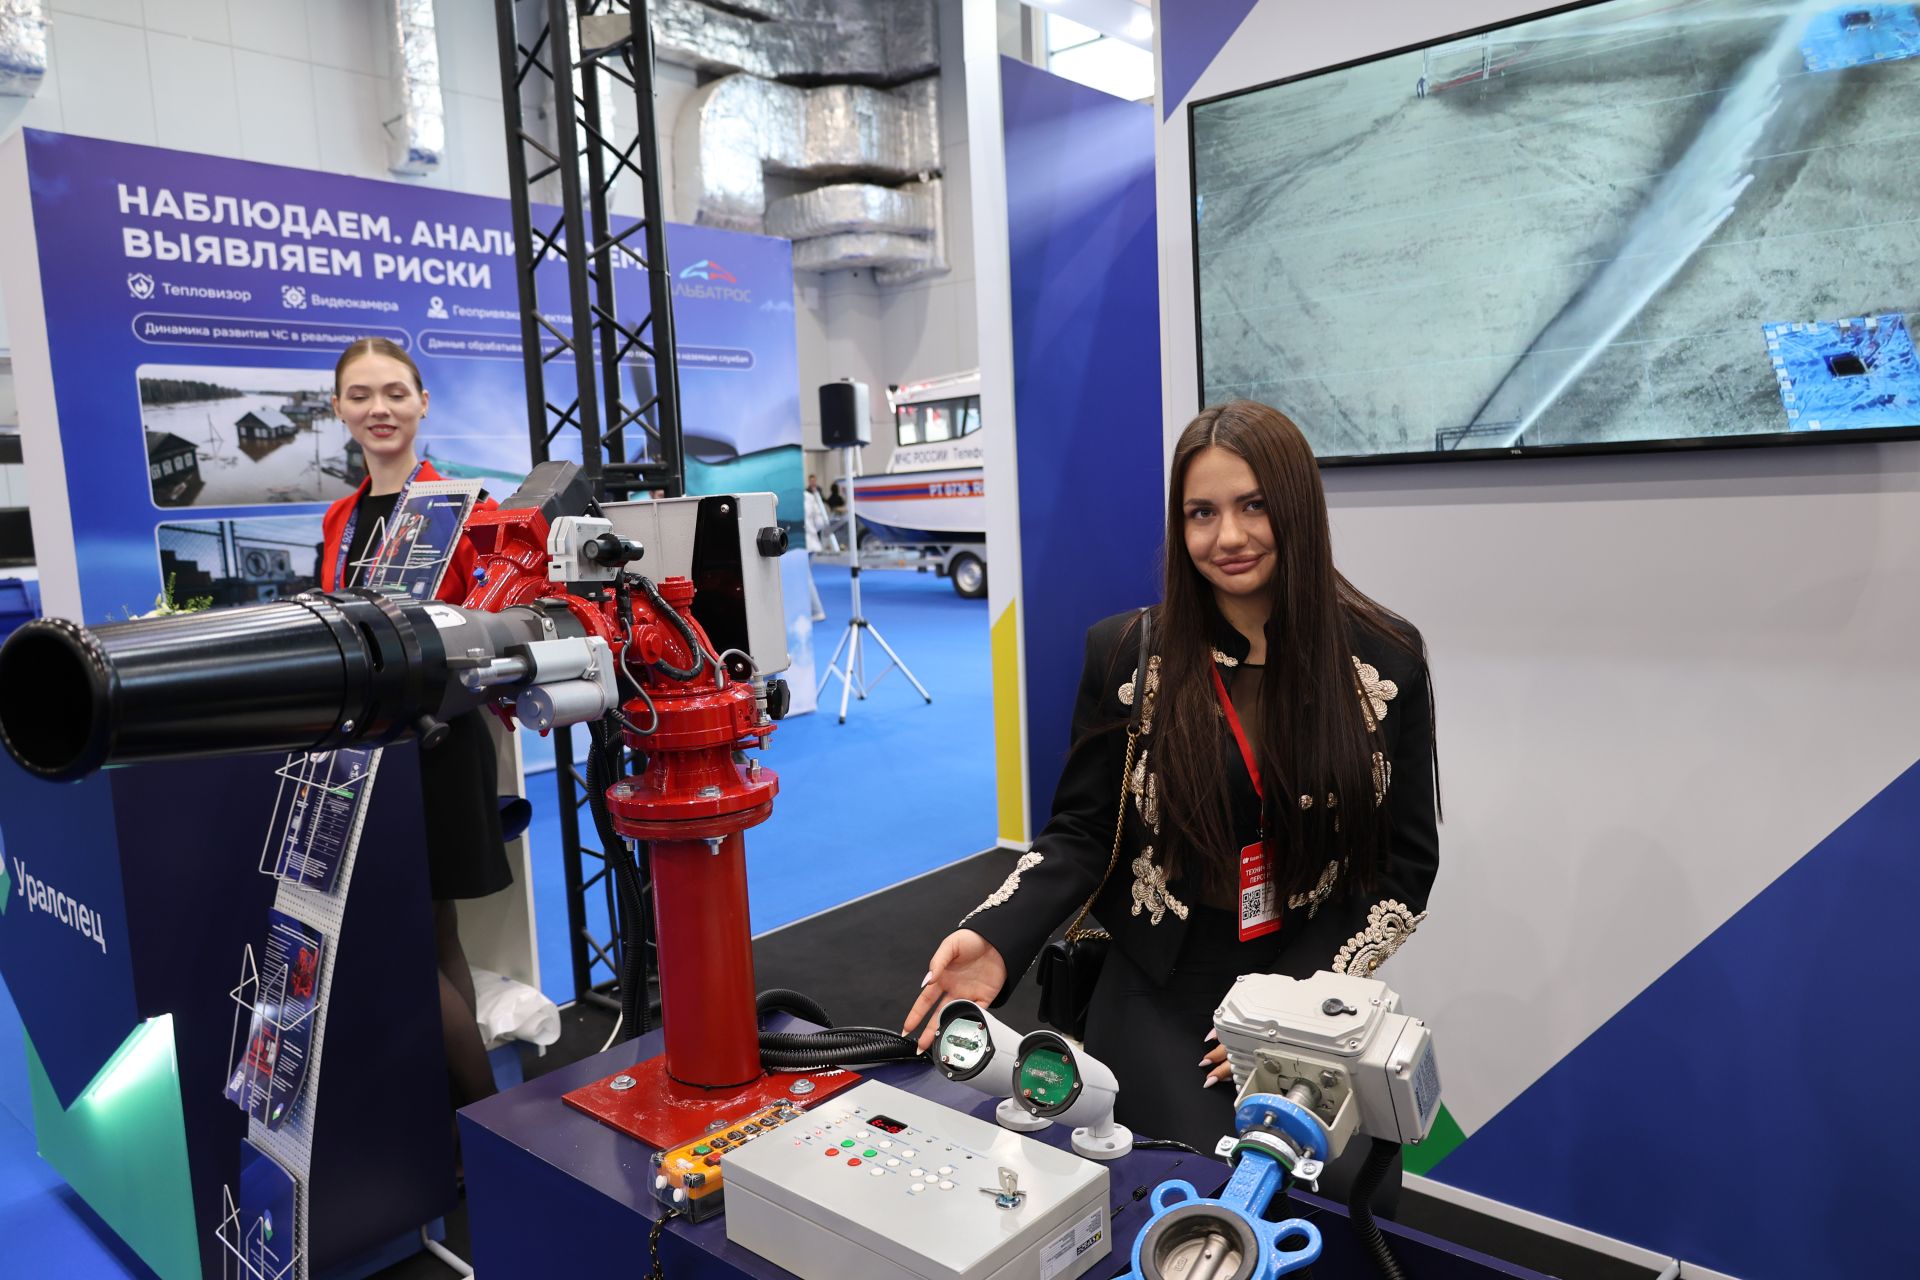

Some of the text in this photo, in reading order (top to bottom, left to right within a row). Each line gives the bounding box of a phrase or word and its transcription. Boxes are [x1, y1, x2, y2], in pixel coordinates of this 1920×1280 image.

[118, 184, 403, 246] НАБЛЮДАЕМ.
[122, 227, 492, 290] ВЫЯВЛЯЕМ РИСКИ
[162, 282, 252, 303] Тепловизор
[672, 283, 752, 304] ЛЬБАТРОС
[311, 294, 400, 313] Видеокамера
[145, 322, 210, 338] Динамика
[213, 327, 269, 340] развития
[272, 330, 289, 341] ЧС
[291, 332, 299, 341] в
[428, 338, 466, 350] Данные
[914, 449, 948, 463] РОССИИ
[952, 447, 984, 461] Телеф
[342, 522, 356, 543] 2026
[13, 856, 107, 954] Уралспец
